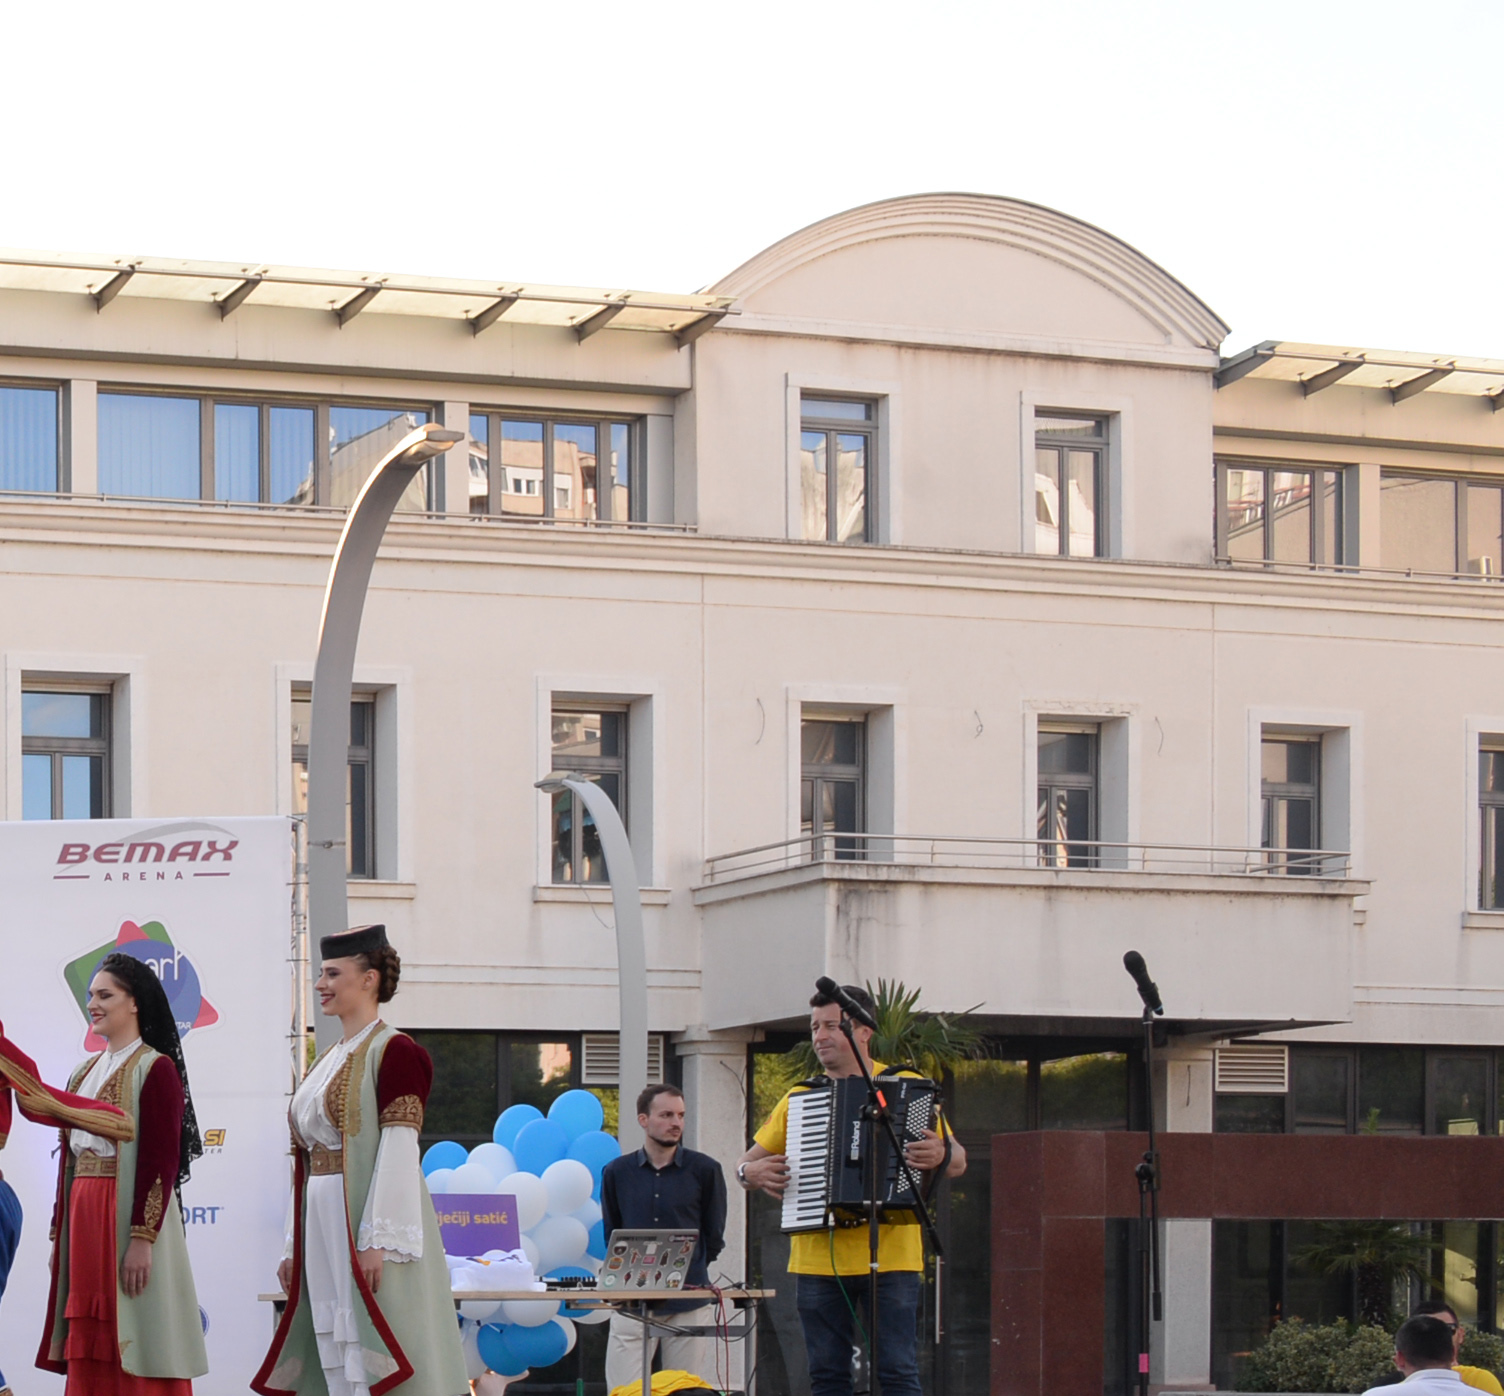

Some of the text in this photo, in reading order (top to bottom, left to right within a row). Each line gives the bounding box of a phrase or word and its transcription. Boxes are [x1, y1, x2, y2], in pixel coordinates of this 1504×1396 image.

[56, 840, 239, 865] BEMAX
[104, 871, 184, 881] ARENA
[851, 1120, 861, 1149] Roland
[438, 1211, 470, 1227] ječiji
